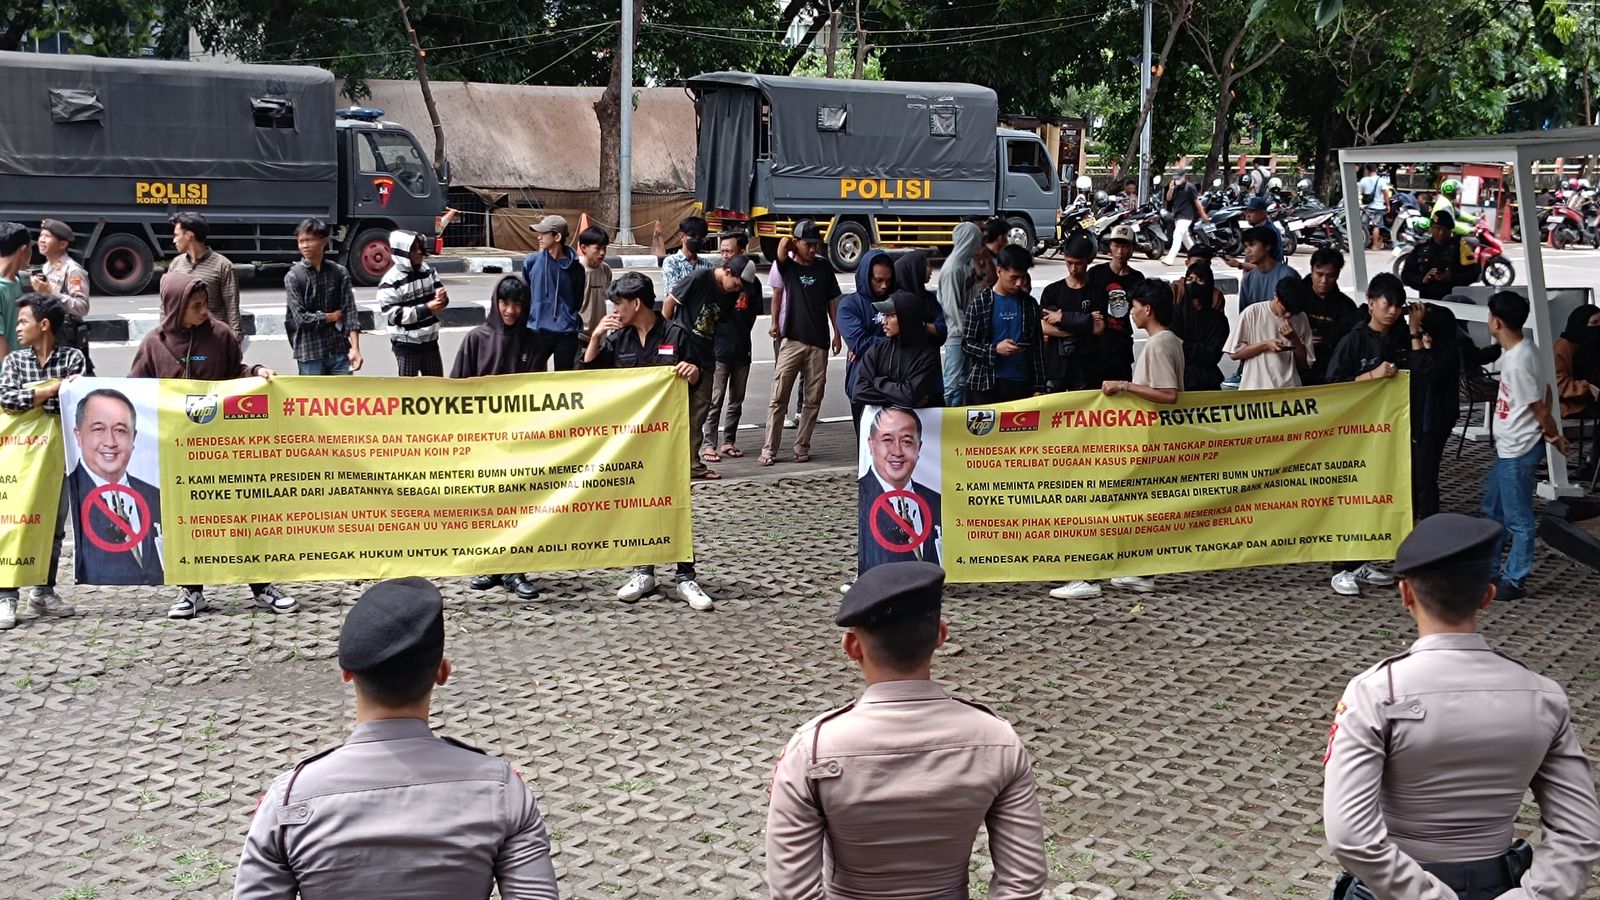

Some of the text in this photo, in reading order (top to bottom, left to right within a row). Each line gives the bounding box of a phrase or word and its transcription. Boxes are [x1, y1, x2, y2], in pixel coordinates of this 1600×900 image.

[136, 182, 208, 198] POLISI
[841, 179, 930, 199] POLISI
[283, 391, 585, 417] #TANGKAPROYKETUMILAAR
[1051, 398, 1319, 428] #TANGKAPROYKETUMILAAR
[175, 421, 670, 447] 1. MENDESAK KPK SEGERA MEMERIKSA DAN TANGKAP DIREKTUR UTAMA BNI ROYKE TUMILAAR
[955, 424, 1391, 456] 1. MENDESAK KPK SEGERA MEMERIKSA DAN TANGKAP DIREKTUR UTAMA BNI ROYKE TUMILAAR
[188, 447, 471, 460] DIDUGA TERLIBAT DUGAAN KASUS PENIPUAN KOIN P2P
[967, 452, 1219, 469] DIDUGA TERLIBAT DUGAAN KASUS PENIPUAN KOIN P2P
[176, 460, 644, 485] 2. KAMI MEMINTA PRESIDEN RI MEMERINTAHKAN MENTERI BUMN UNTUK MEMECAT SAUDARA
[967, 483, 990, 491] KAMI
[992, 481, 1035, 490] MEMINTA
[1038, 480, 1084, 489] PRESIDEN
[1086, 480, 1096, 488] RI
[1099, 476, 1178, 488] MEMERINTAHKAN
[1181, 472, 1220, 483] MENTERI
[1222, 470, 1248, 480] BUMN
[1251, 467, 1280, 478] UNTUK
[1282, 462, 1322, 474] MEMECAT
[1324, 460, 1367, 470] SAUDARA
[191, 476, 635, 500] ROYKE TUMILAAR DARI JABATANNYA SEBAGAI DIREKTUR BANK NASIONAL INDONESIA
[968, 475, 1358, 506] ROYKE TUMILAAR DARI JABATANNYA SEBAGAI DIREKTUR BANK NASIONAL INDONESIA
[178, 496, 672, 525] 3. MENDESAK PIHAK KEPOLISIAN UNTUK SEGERA MEMERIKSA DAN MENAHAN ROYKE TUMILAAR
[956, 495, 1393, 527] 3. MENDESAK PIHAK KEPOLISIAN UNTUK SEGERA MEMERIKSA DAN MENAHAN ROYKE TUMILAAR
[191, 519, 518, 539] (DIRUT BNI) AGAR DIHUKUM SESUAI DENGAN UU YANG BERLAKU
[967, 516, 1253, 540] (DIRUT BNI) AGAR DIHUKUM SESUAI DENGAN UU YANG BERLAKU
[180, 536, 670, 565] 4. MENDESAK PARA PENEGAK HUKUM UNTUK TANGKAP DAN ADILI ROYKE TUMILAAR
[956, 533, 1392, 564] 4. MENDESAK PARA PENEGAK HUKUM UNTUK TANGKAP DAN ADILI ROYKE TUMILAAR
